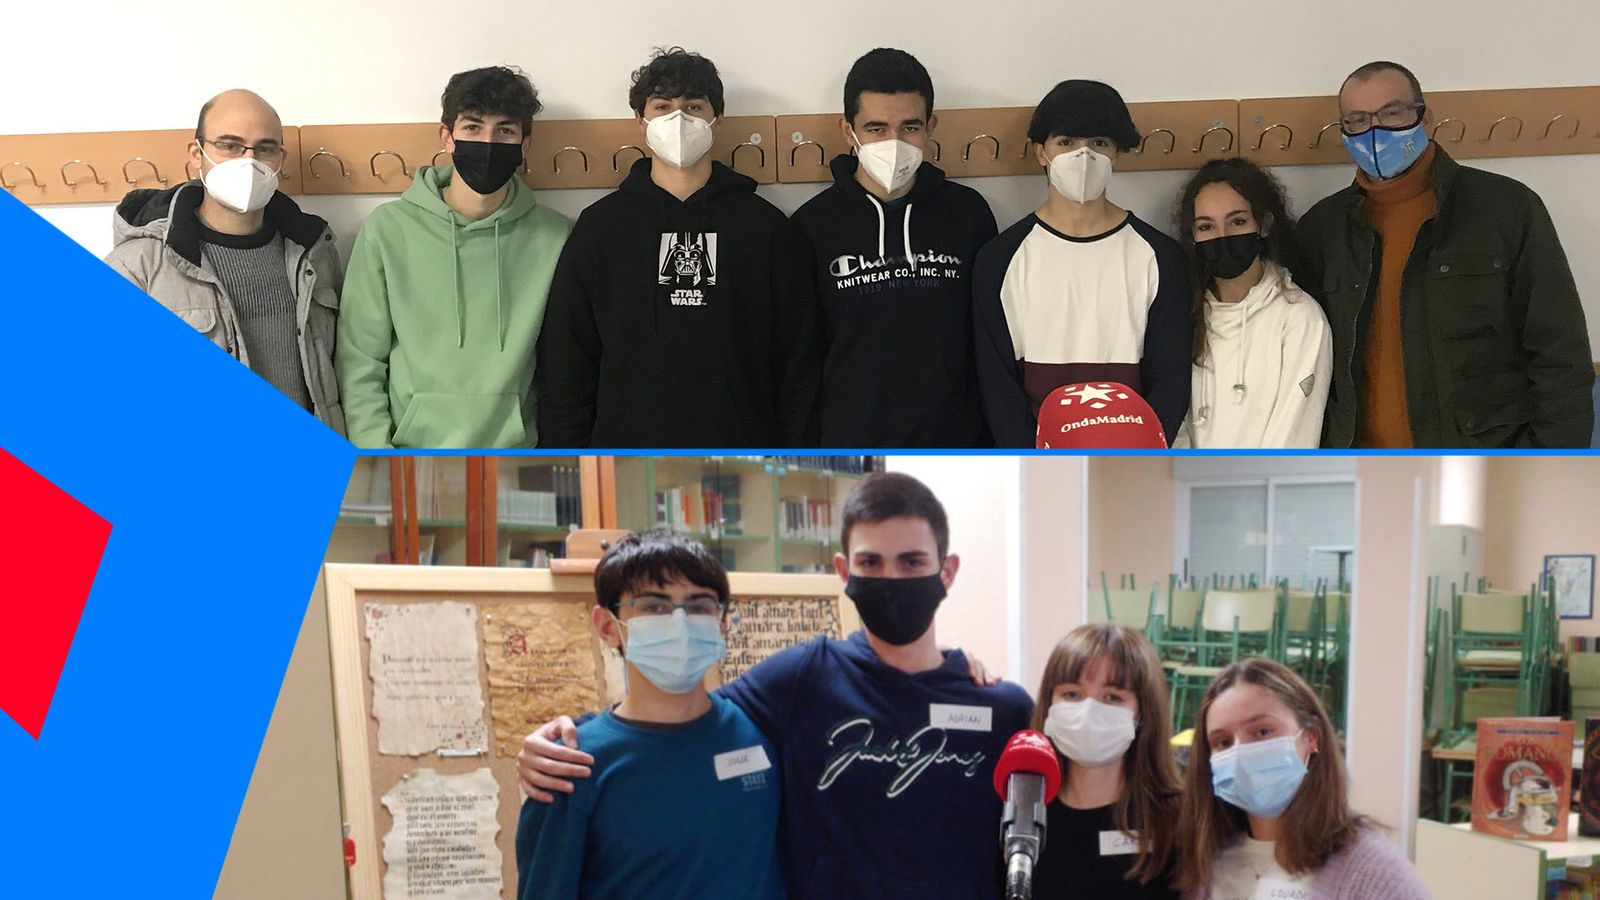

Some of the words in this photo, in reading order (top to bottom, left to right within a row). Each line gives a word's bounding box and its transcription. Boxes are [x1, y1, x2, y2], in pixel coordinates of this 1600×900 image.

[836, 271, 891, 290] KNITWEAR
[920, 267, 941, 277] INC.
[945, 269, 960, 279] NY.
[670, 289, 704, 298] STAR
[670, 297, 703, 306] WARS
[1060, 414, 1144, 433] OndaMadrid
